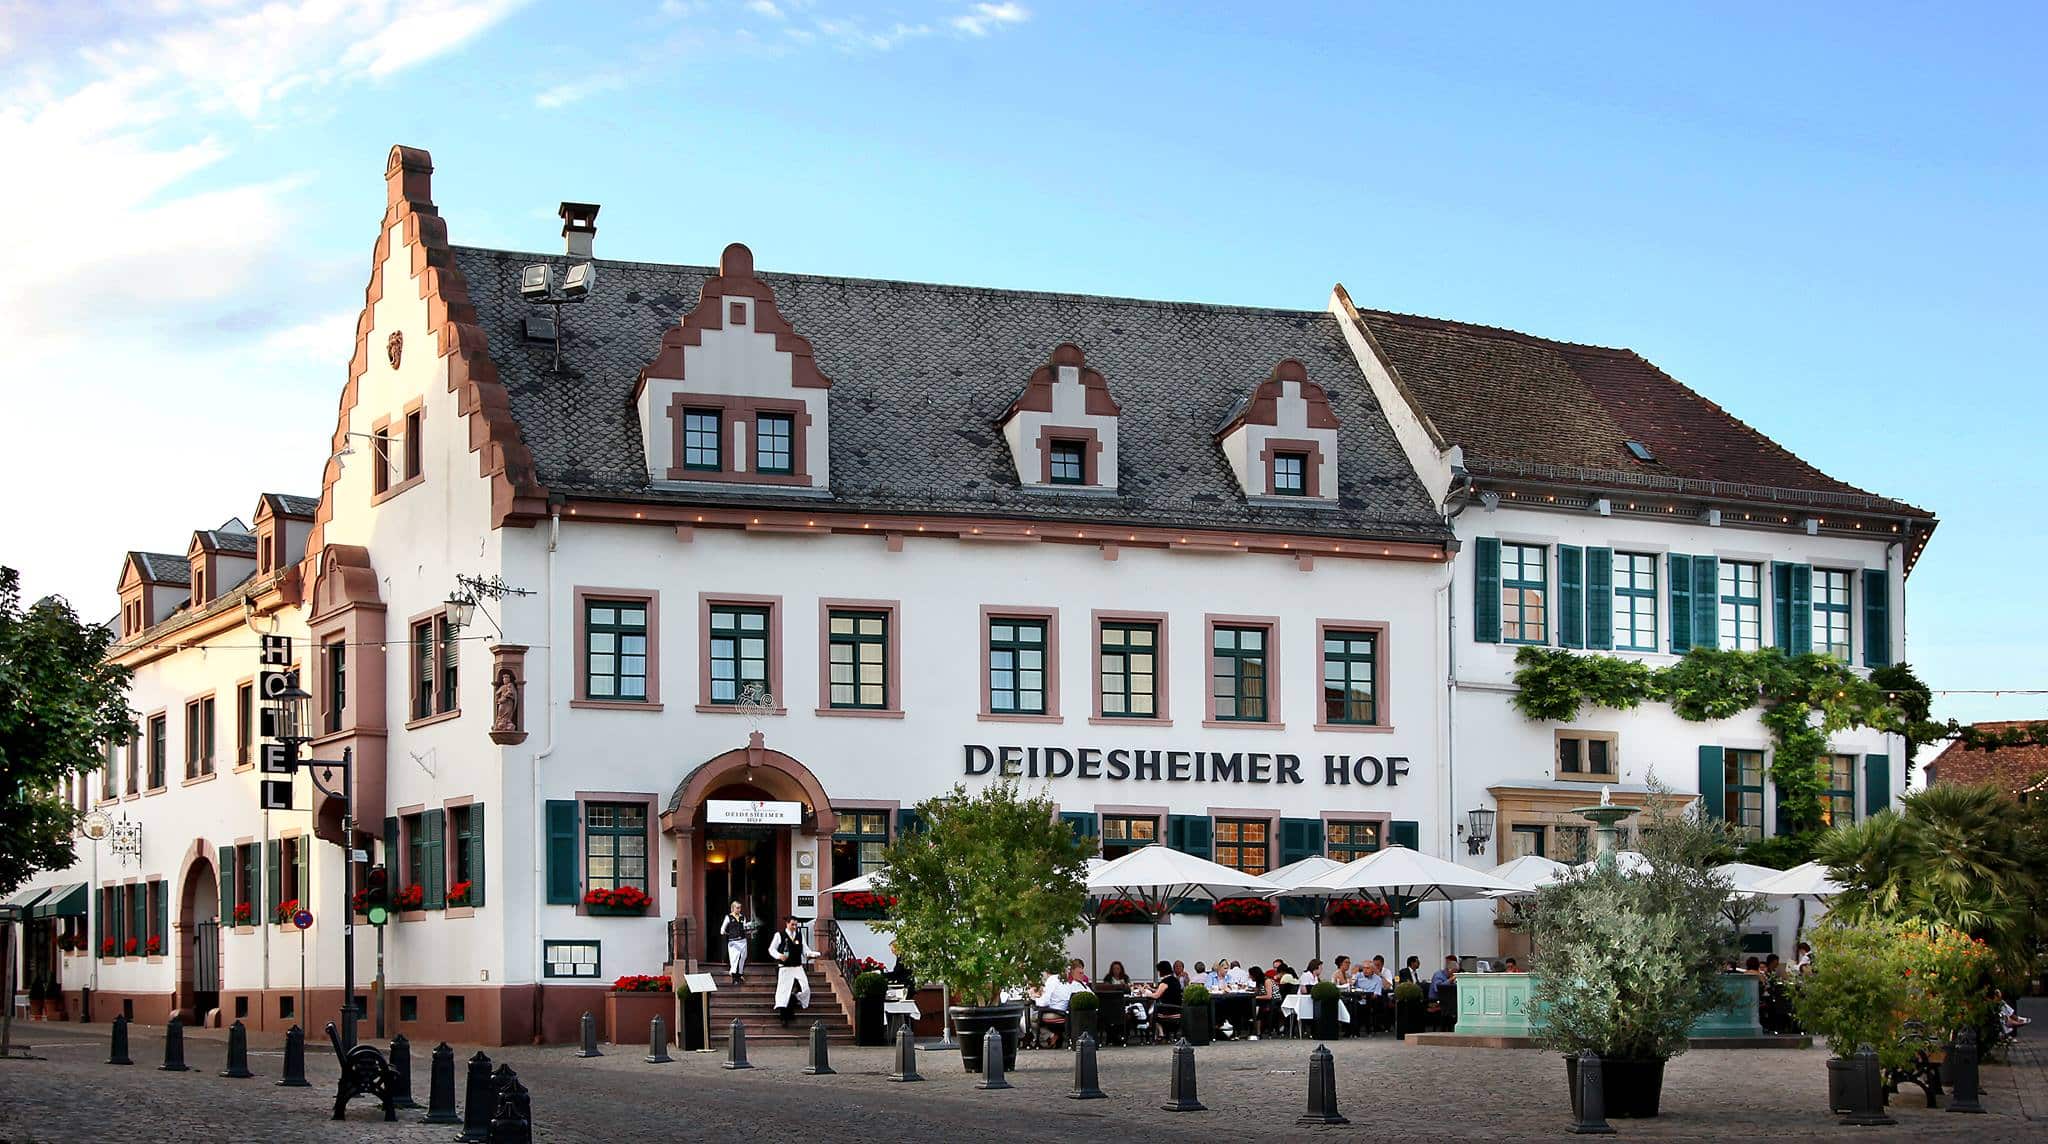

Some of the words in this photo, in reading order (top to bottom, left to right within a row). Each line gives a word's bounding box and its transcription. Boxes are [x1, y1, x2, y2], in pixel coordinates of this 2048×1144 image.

[264, 636, 289, 809] HOTEL
[963, 744, 1304, 785] DEIDESHEIMER
[1324, 754, 1410, 787] HOF
